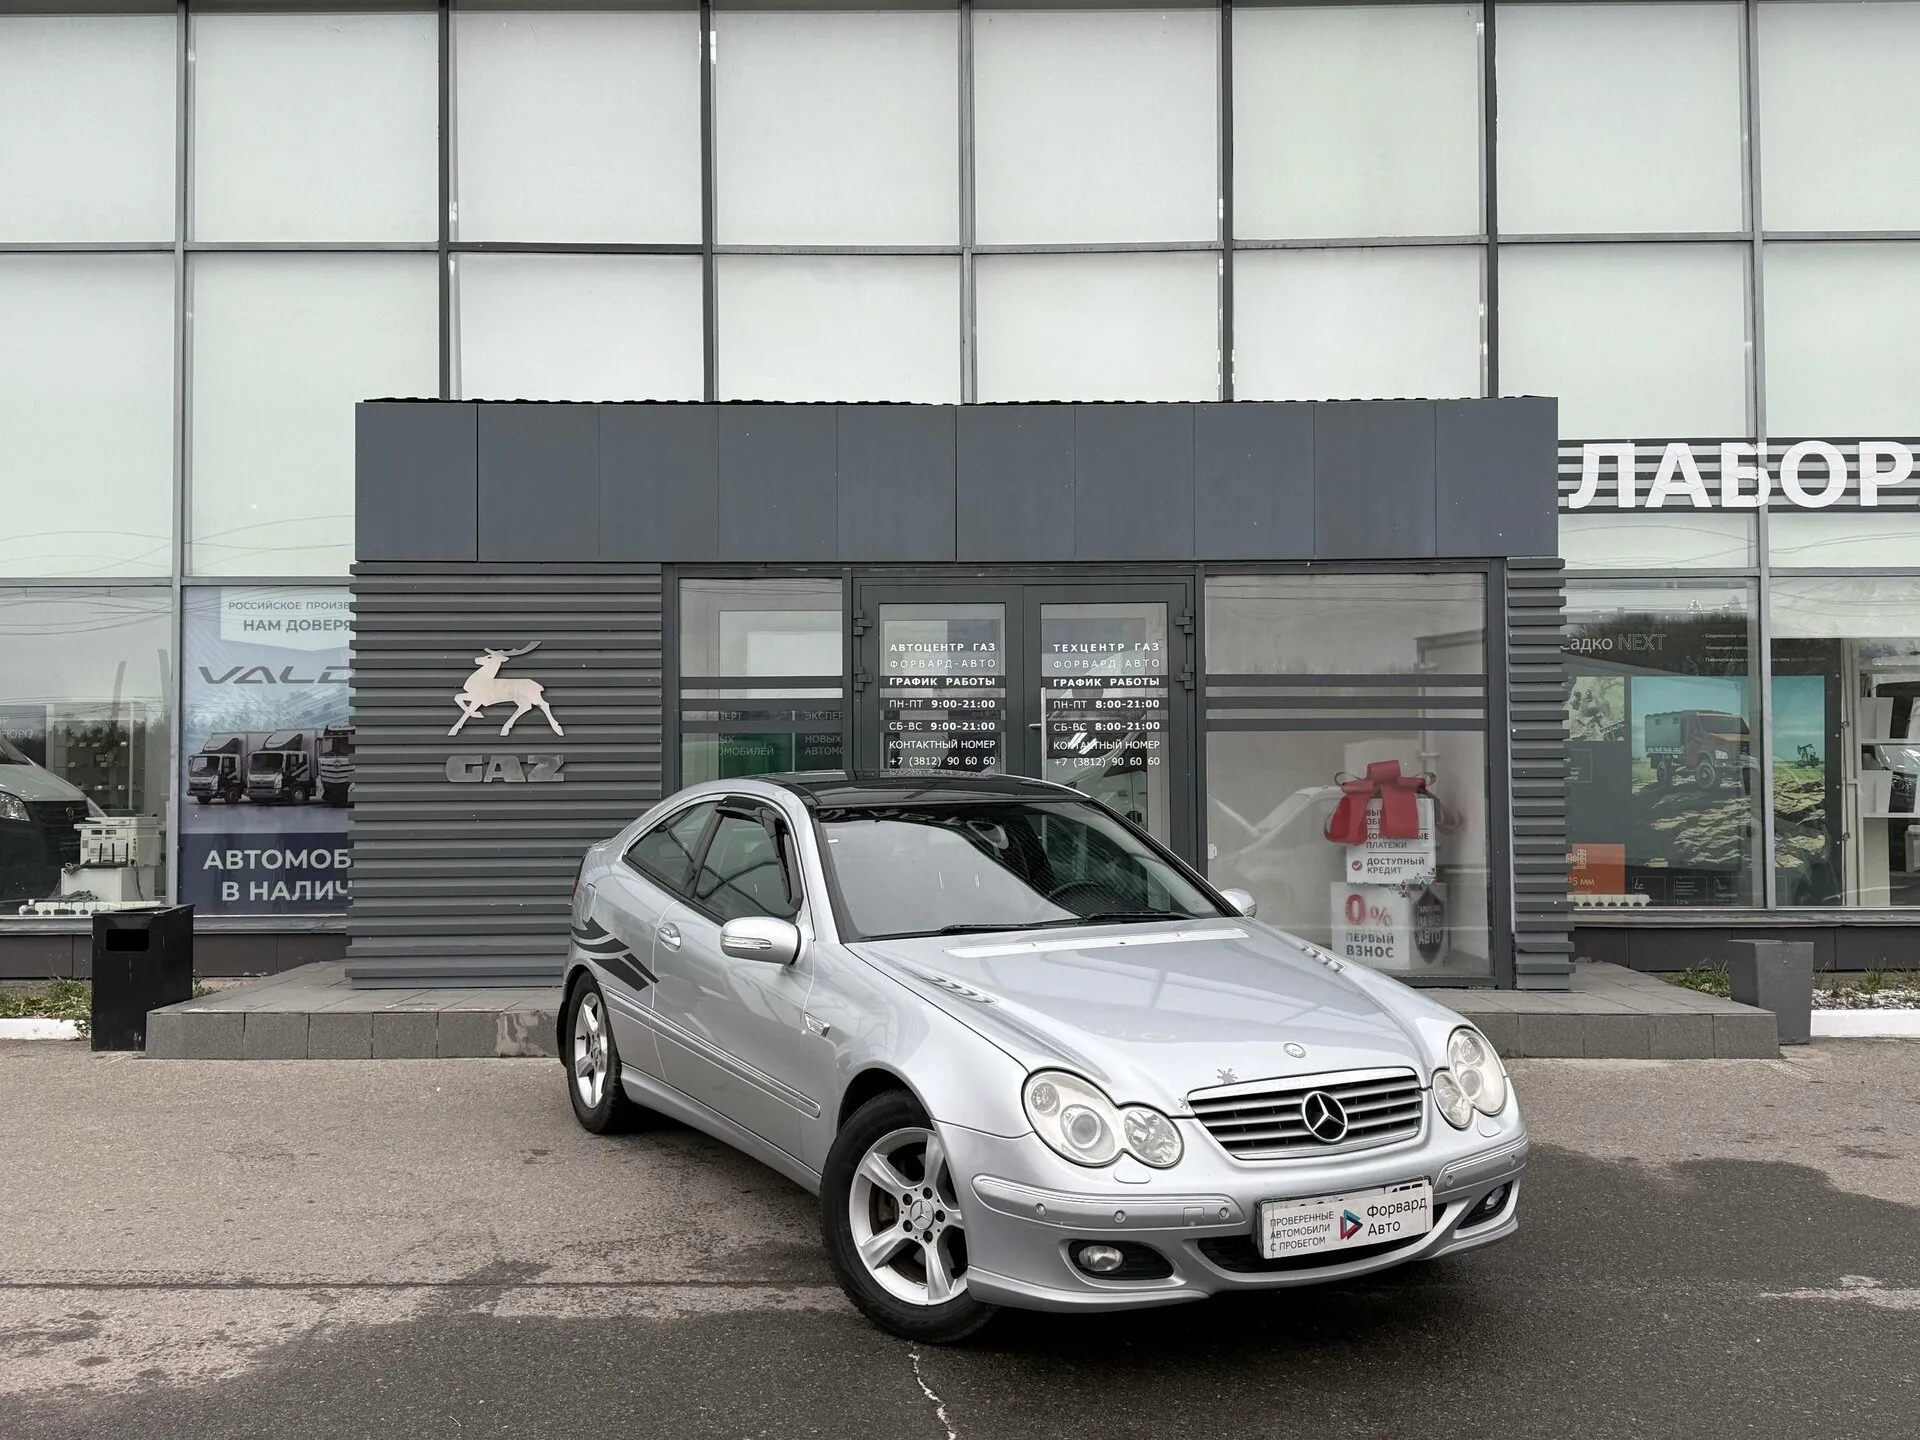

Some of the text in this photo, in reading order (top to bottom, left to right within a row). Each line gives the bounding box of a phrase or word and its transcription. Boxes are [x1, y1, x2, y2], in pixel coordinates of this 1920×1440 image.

[228, 600, 302, 610] РОССИЙСКОЕ
[243, 619, 281, 632] НАМ
[890, 642, 996, 653] АВТОЦЕНТР ГАЗ
[1053, 642, 1160, 653] ТЕХЦЕНТР ГАЗ
[1618, 633, 1668, 651] NEXT
[890, 659, 996, 669] ФОРВАРД-АВТО
[1053, 659, 1160, 669] ФОРВАРД АВТО
[889, 677, 996, 686] ГРАФИК РАБОТЫ
[1053, 677, 1160, 687] ГРАФИК РАБОТЫ
[889, 699, 996, 708] ПН-ПТ 9:00-21:00
[1053, 699, 1160, 709] ПН-ПТ 8:00-21:00
[889, 722, 996, 731] СБ-ВС 9:00-21:00
[1053, 721, 1160, 732] СБ-ВС 8:00-21:00
[805, 735, 841, 744] НОВЫХ
[889, 739, 996, 749] КОНТАКТНЫЙ НОМЕР
[1125, 740, 1160, 749] НОМЕР
[890, 756, 996, 767] +7 (3812) 90 60 60
[1054, 757, 1160, 768] +7 (3812) 90 60 60
[445, 755, 565, 783] GAZ
[1366, 841, 1407, 849] ПЛАТЕЖИ
[202, 849, 352, 870] АВТОМОБ
[1367, 856, 1425, 867] ДОСТУПНЫЙ
[1367, 866, 1402, 876] КРЕДИТ
[222, 881, 240, 901] В
[1346, 932, 1394, 944] ПЕРВЫЙ
[1346, 945, 1394, 958] ВЗНОС
[1366, 1197, 1427, 1219] Форвард
[1270, 1211, 1334, 1228] ПРОВЕРЕННЫЕ
[1270, 1223, 1331, 1239] АВТОМОБИЛИ
[1367, 1220, 1401, 1236] Авто
[1270, 1236, 1326, 1252] С ПРОБЕГОМ
